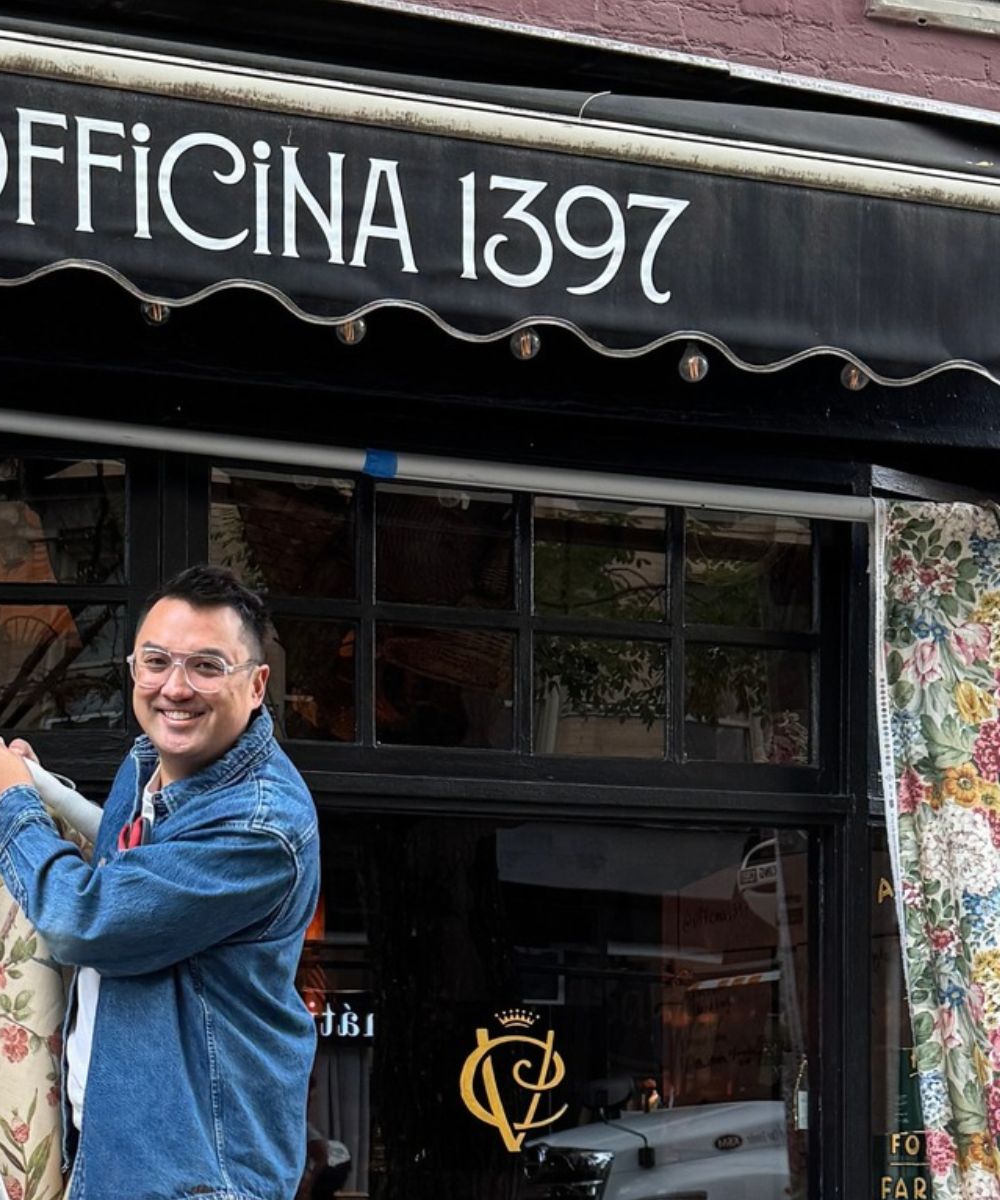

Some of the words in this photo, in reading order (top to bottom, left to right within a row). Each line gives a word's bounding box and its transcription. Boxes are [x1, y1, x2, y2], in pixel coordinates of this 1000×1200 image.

[458, 171, 691, 304] 1397
[890, 1133, 921, 1156] FO
[880, 1175, 928, 1200] FAR
